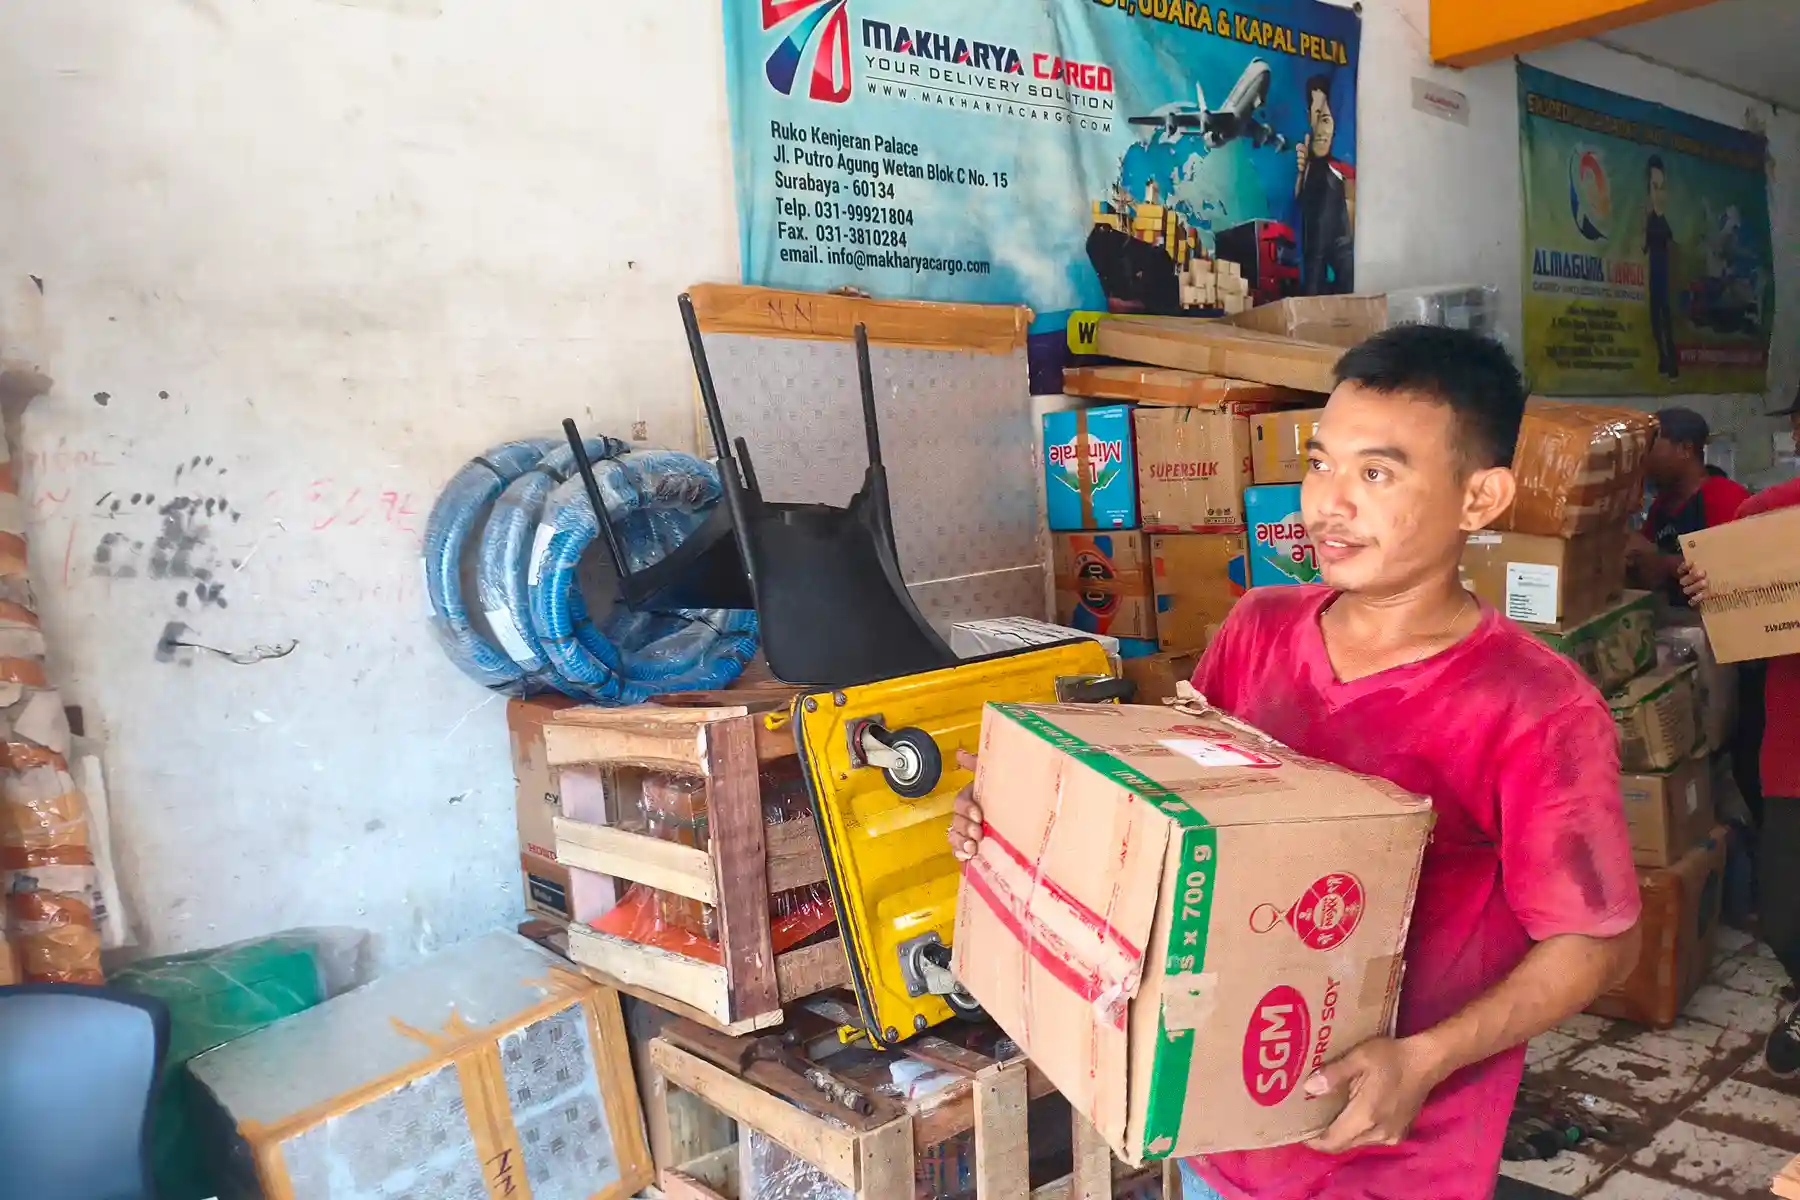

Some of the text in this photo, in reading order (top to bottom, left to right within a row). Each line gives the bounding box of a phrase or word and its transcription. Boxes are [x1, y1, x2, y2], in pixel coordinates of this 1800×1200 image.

[1138, 0, 1213, 33] UDARA
[1217, 11, 1230, 37] &
[1235, 15, 1297, 54] KAPAL
[862, 18, 1113, 93] MAKHARYA CARGO
[865, 55, 1114, 110] YOUR DELIVERY SOLUTION
[868, 83, 1111, 132] WWW.MAKHARYACARGOCOM
[771, 120, 918, 156] Ruko Kenjeran Palace
[773, 144, 1008, 188] Jl. Putro Agung Wetan Blok C No. 15
[775, 170, 840, 197] Surabaya
[853, 180, 895, 200] 60134
[776, 197, 914, 226] Telp. 031-99921804
[777, 221, 907, 248] Fax. 031-3810284
[780, 245, 990, 275] email. info@makharyacargo.com
[1078, 321, 1095, 344] W
[1050, 441, 1122, 468] Minrale
[1149, 461, 1219, 478] SUPERSILK
[1256, 523, 1307, 547] erale
[1290, 544, 1318, 569] Le
[1193, 845, 1213, 863] g
[1182, 871, 1206, 921] 700
[1321, 976, 1341, 1022] SOY
[1256, 1004, 1294, 1094] SGM
